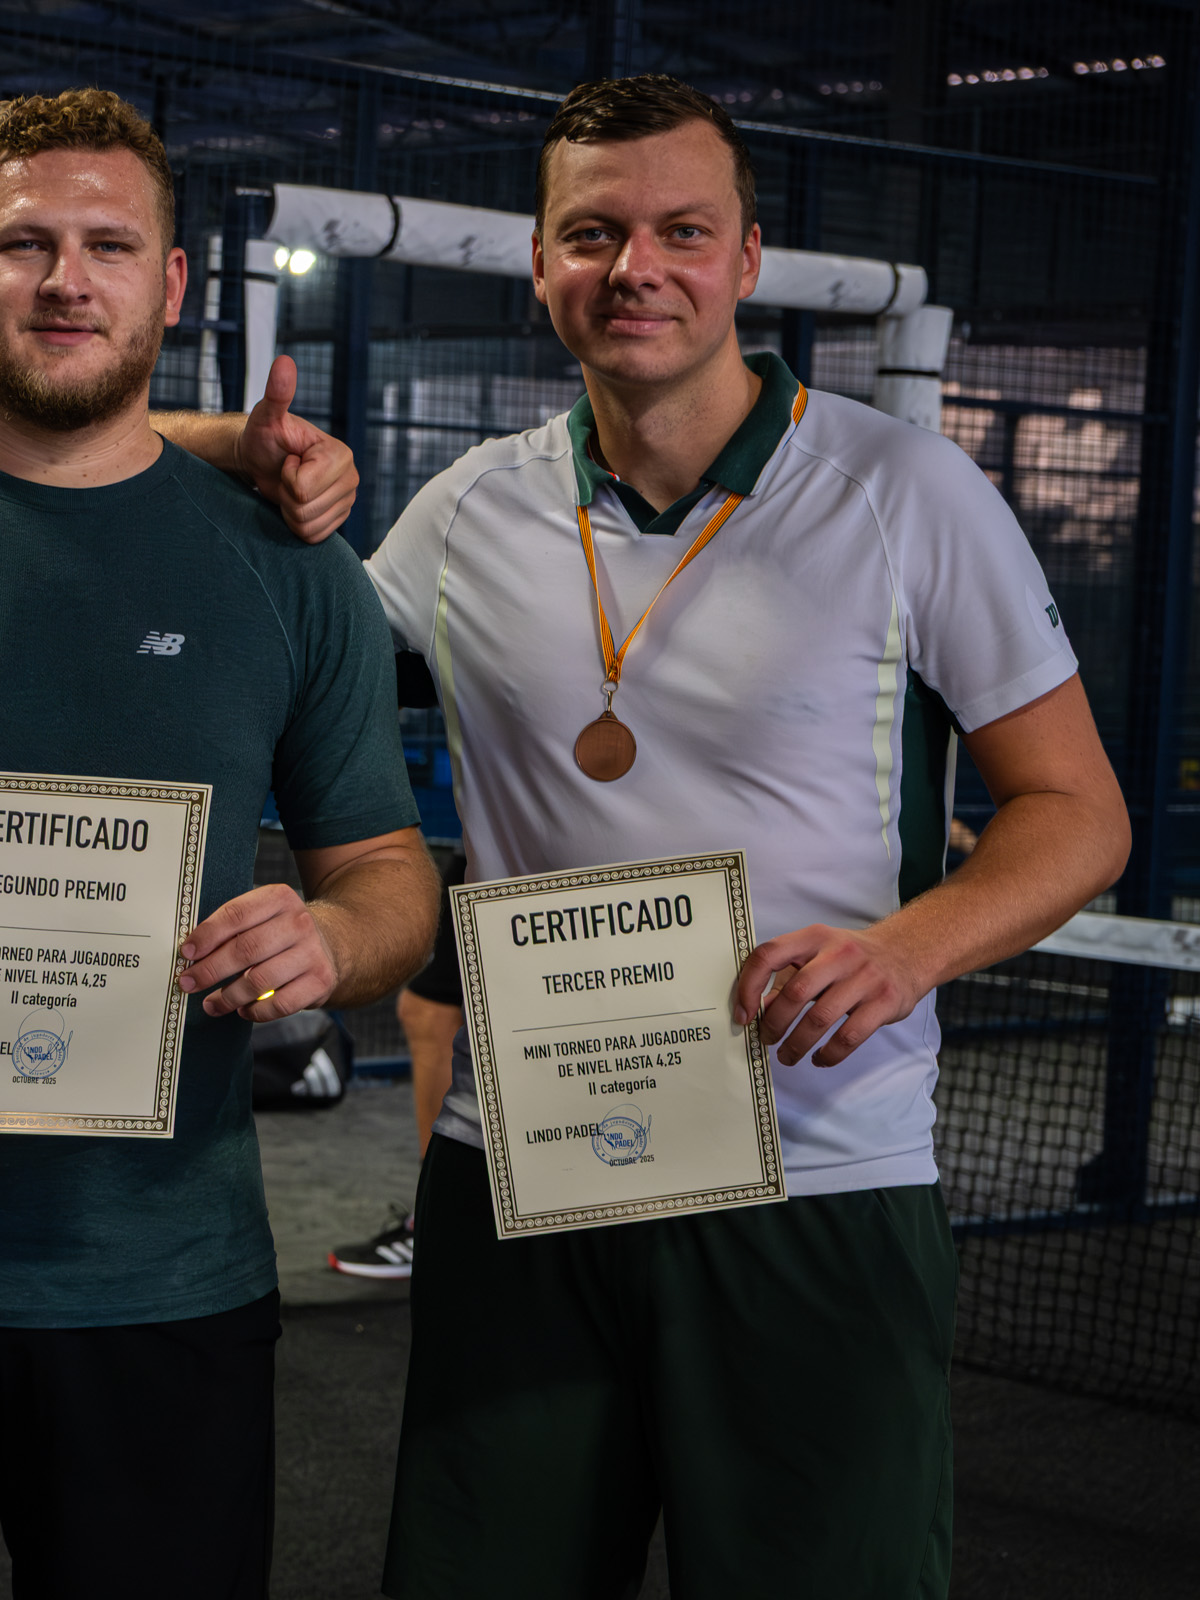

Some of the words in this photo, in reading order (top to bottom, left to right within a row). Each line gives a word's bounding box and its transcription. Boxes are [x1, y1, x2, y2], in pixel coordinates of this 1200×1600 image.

[64, 878, 127, 902] PREMIO
[510, 893, 693, 947] CERTIFICADO
[37, 948, 67, 964] PARA
[70, 950, 140, 968] JUGADORES
[4, 968, 38, 984] NIVEL
[41, 970, 78, 986] HASTA
[81, 973, 107, 988] 4,25
[542, 970, 606, 995] TERCER
[611, 961, 675, 988] PREMIO
[11, 990, 19, 1004] II
[22, 992, 77, 1010] categoría
[523, 1043, 551, 1060] MINI
[553, 1038, 601, 1057] TORNEO
[605, 1034, 637, 1052] PARA
[640, 1026, 711, 1048] JUGADORES
[558, 1063, 574, 1078] DE
[576, 1059, 612, 1076] NIVEL
[615, 1054, 653, 1072] HASTA
[656, 1051, 682, 1067] 4,25
[12, 1075, 40, 1084] OCTUBRE
[42, 1077, 57, 1085] 2025
[588, 1081, 597, 1096] II
[600, 1075, 657, 1095] categoría
[526, 1127, 562, 1144] LINDO
[565, 1123, 604, 1139] PADEL
[609, 1156, 637, 1167] OCTUBRE
[640, 1154, 655, 1163] 2025
